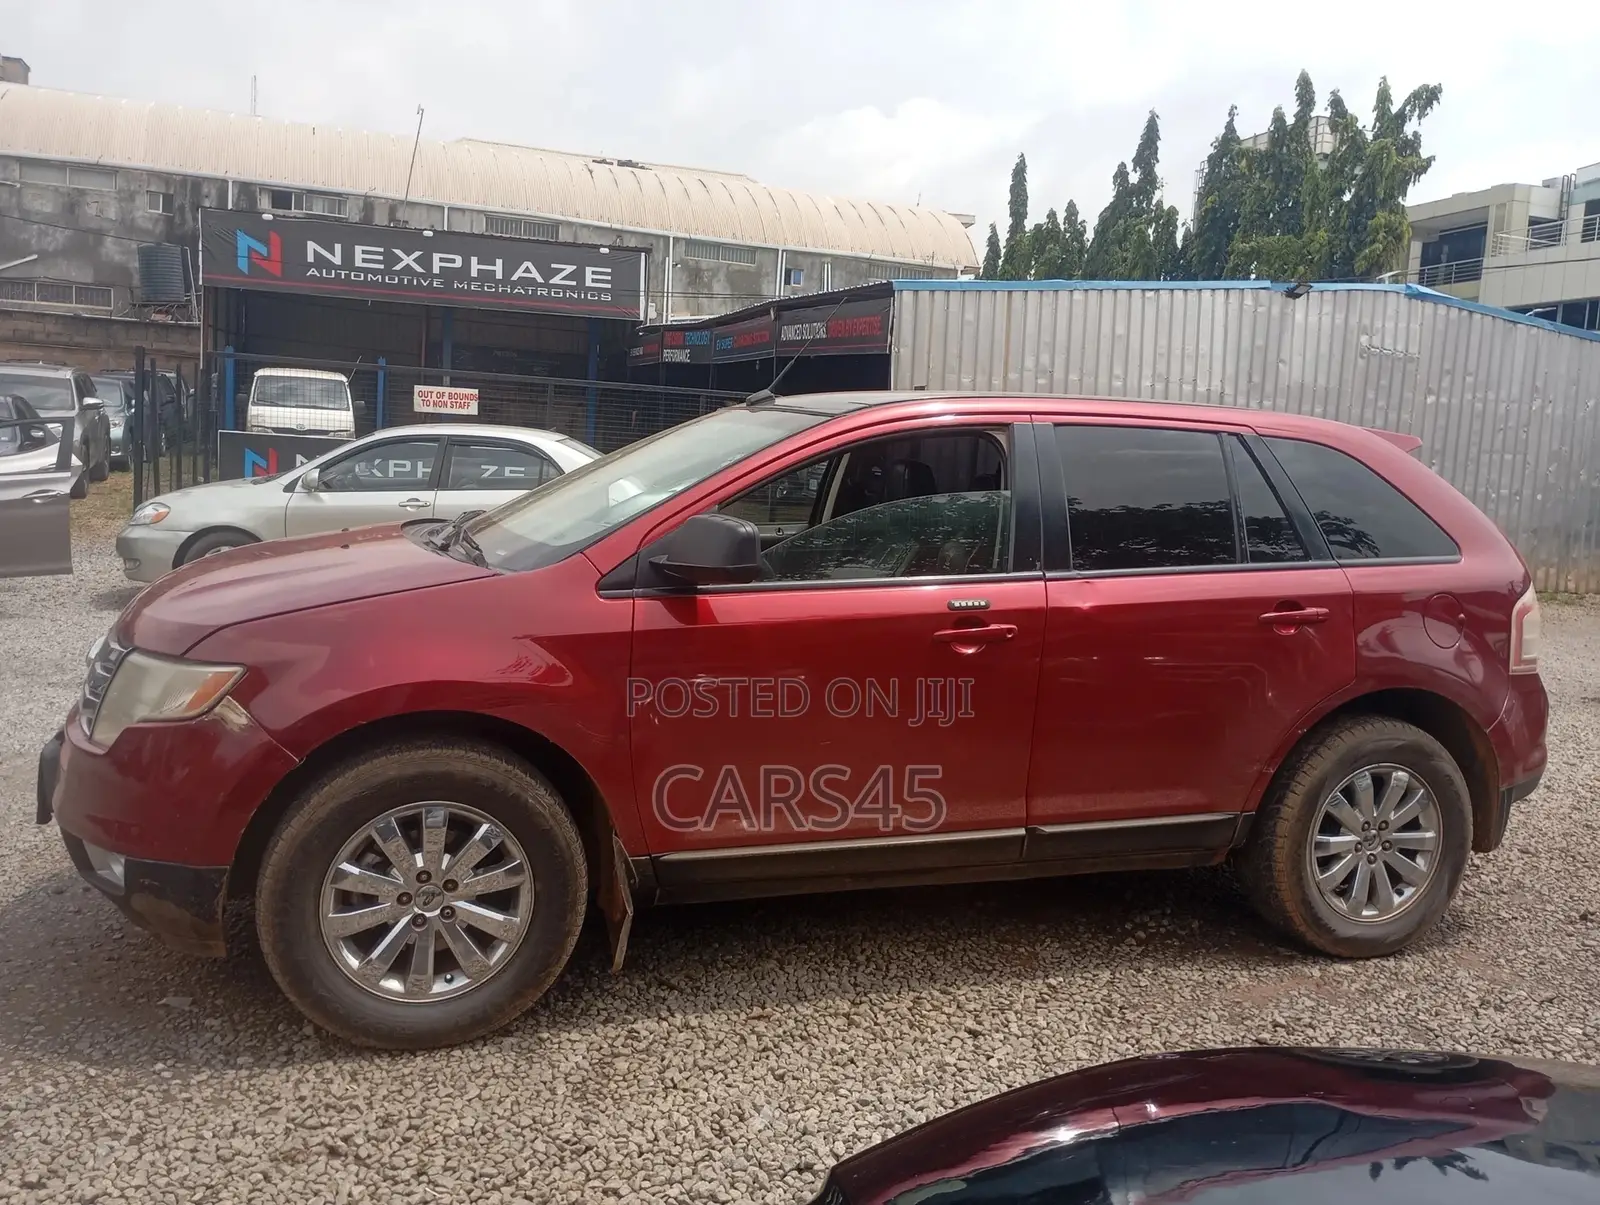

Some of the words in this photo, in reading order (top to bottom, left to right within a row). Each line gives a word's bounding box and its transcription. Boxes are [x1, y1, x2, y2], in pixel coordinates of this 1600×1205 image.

[306, 240, 612, 288] NEXPHAZE
[306, 268, 444, 288] AUTOMOTIVE
[454, 281, 612, 301] MECHATRONICS
[663, 348, 690, 362] PERFORMANCE
[418, 390, 434, 399] OUT
[436, 391, 446, 400] OF
[448, 392, 479, 402] BOUNDS
[421, 399, 431, 407] TO
[433, 400, 448, 408] NON
[450, 401, 471, 410] STAFF
